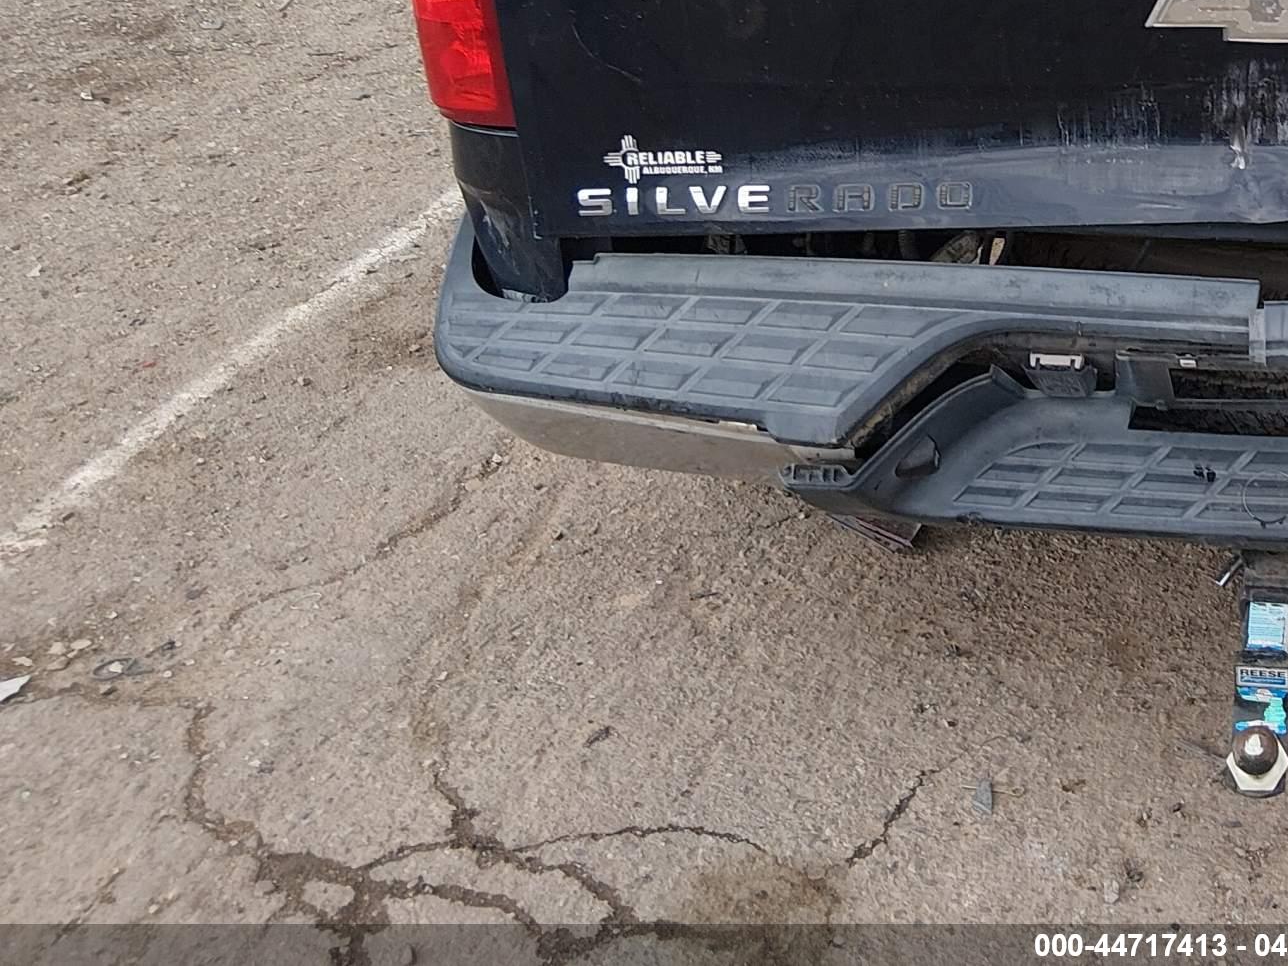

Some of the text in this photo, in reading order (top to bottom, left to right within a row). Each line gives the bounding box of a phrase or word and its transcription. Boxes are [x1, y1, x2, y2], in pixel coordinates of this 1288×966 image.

[626, 151, 706, 165] RELIABLE
[708, 165, 723, 173] NM
[576, 182, 974, 217] SILVERADO
[1240, 669, 1286, 677] REESE
